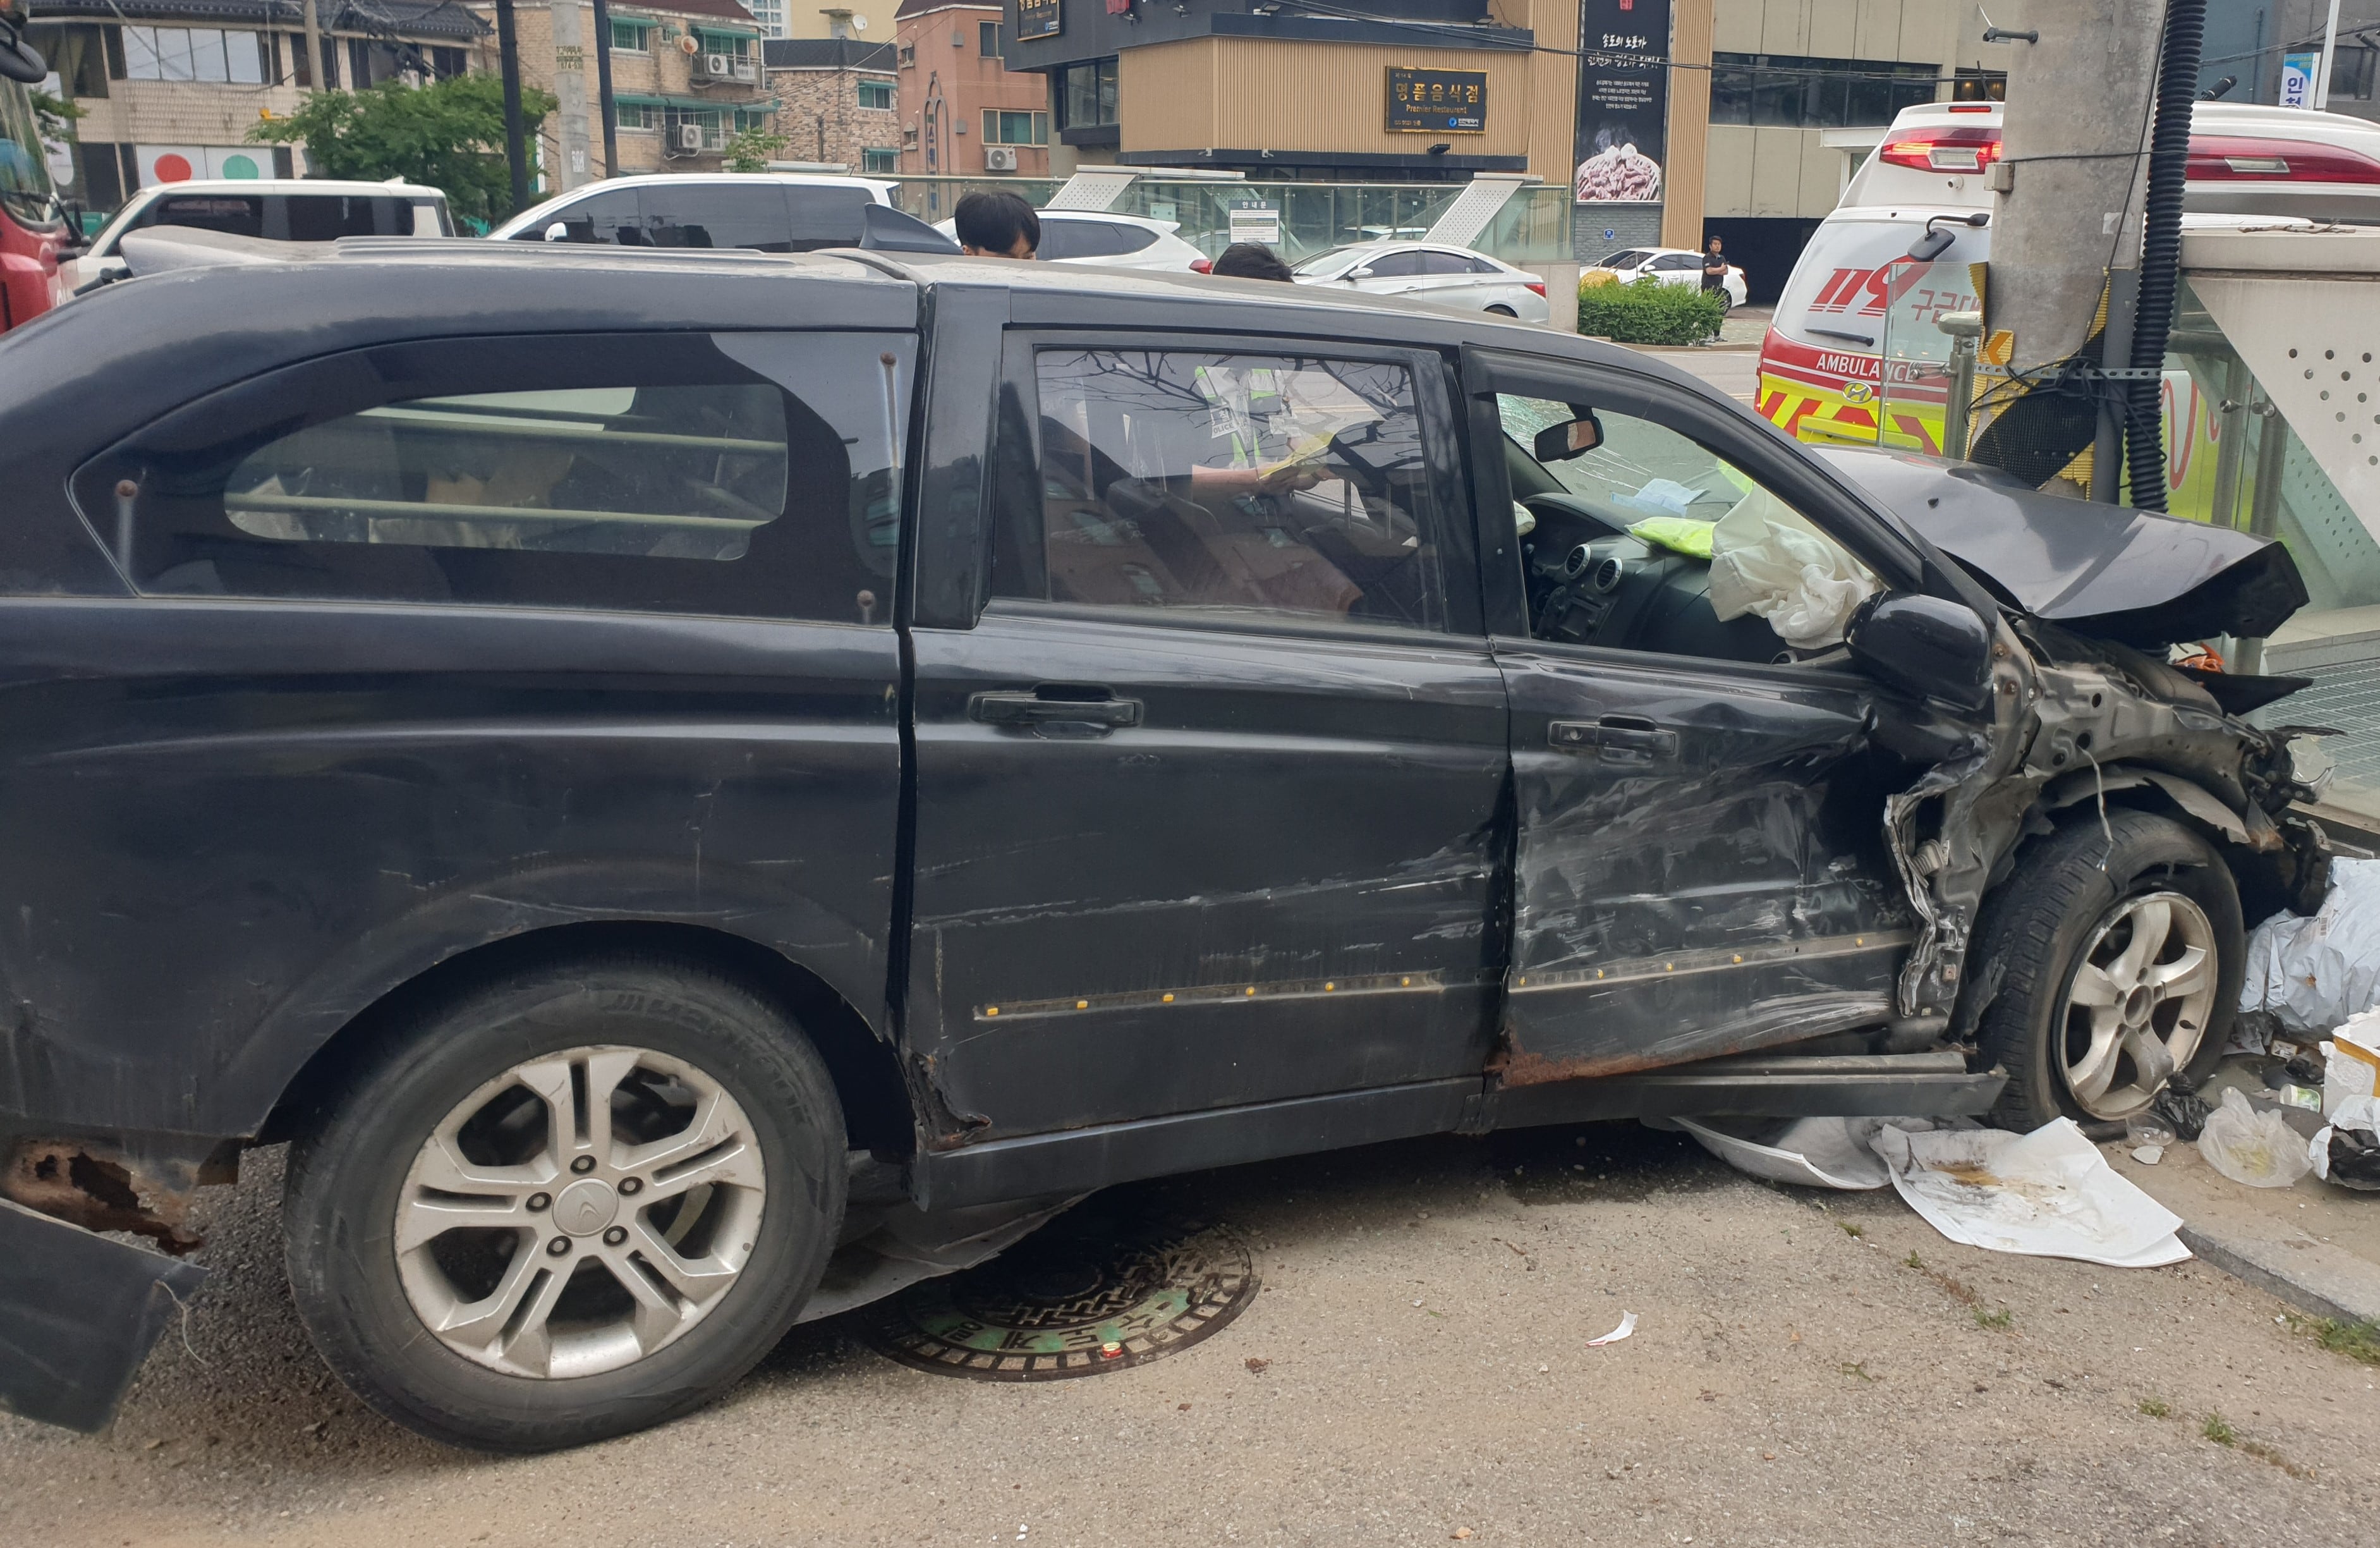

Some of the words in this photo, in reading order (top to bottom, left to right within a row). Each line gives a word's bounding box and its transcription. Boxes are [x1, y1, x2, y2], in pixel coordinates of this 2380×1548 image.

[1602, 34, 1624, 48] 송도의
[1625, 35, 1648, 49] 노포가
[1395, 83, 1478, 103] 명품음식점
[1406, 104, 1431, 113] Premier
[1807, 254, 1934, 317] 119
[1213, 422, 1235, 434] OLICE
